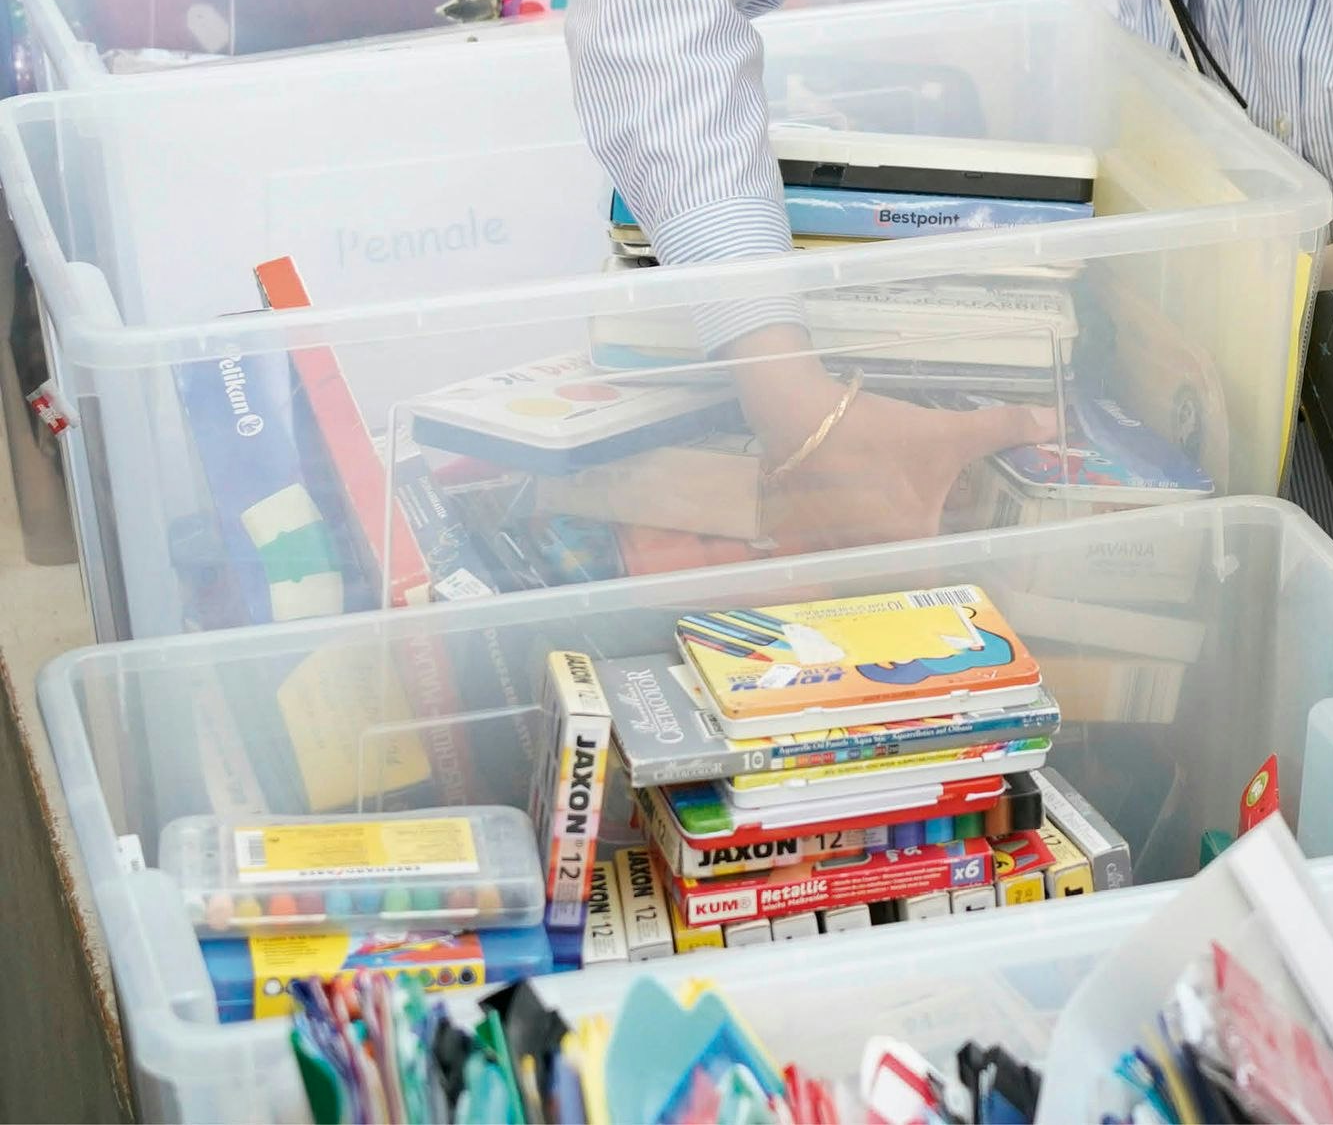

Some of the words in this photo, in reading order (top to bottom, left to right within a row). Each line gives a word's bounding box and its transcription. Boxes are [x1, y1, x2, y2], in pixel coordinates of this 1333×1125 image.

[878, 208, 961, 229] Bestpoint
[564, 653, 593, 684] JAXON
[626, 668, 685, 744] CRETACOLOR
[742, 751, 764, 771] 10
[697, 838, 798, 867] JAXON
[815, 830, 843, 851] 12
[558, 852, 581, 880] 12
[626, 849, 655, 898] JAXON
[953, 861, 980, 881] x6
[760, 879, 828, 905] Metallic
[635, 906, 657, 922] 12
[592, 924, 613, 939] 12
